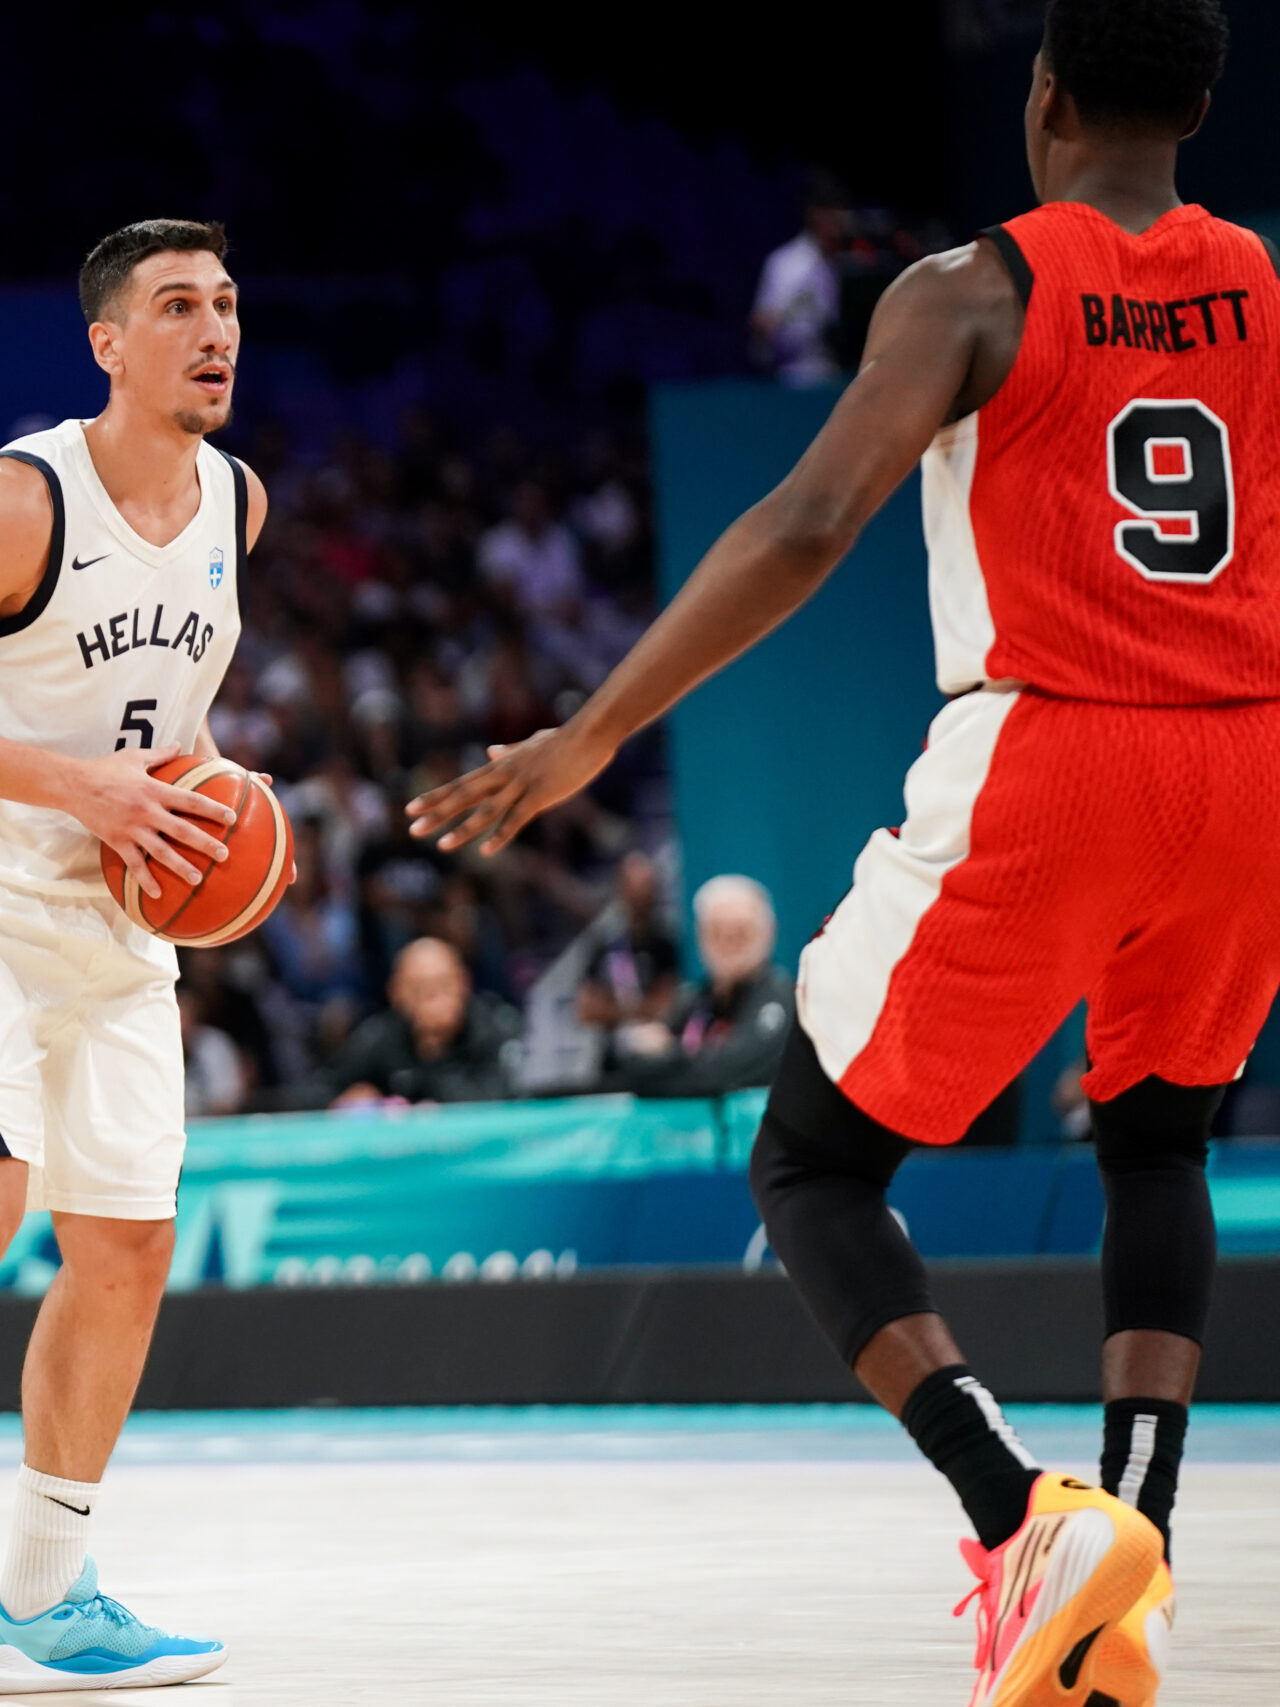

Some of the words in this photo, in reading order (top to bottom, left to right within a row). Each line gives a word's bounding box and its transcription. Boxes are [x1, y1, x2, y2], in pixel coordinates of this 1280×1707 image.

[1080, 289, 1249, 354] BARRETT
[1106, 398, 1235, 583] 9
[76, 603, 214, 669] HELLAS
[114, 699, 158, 752] 5
